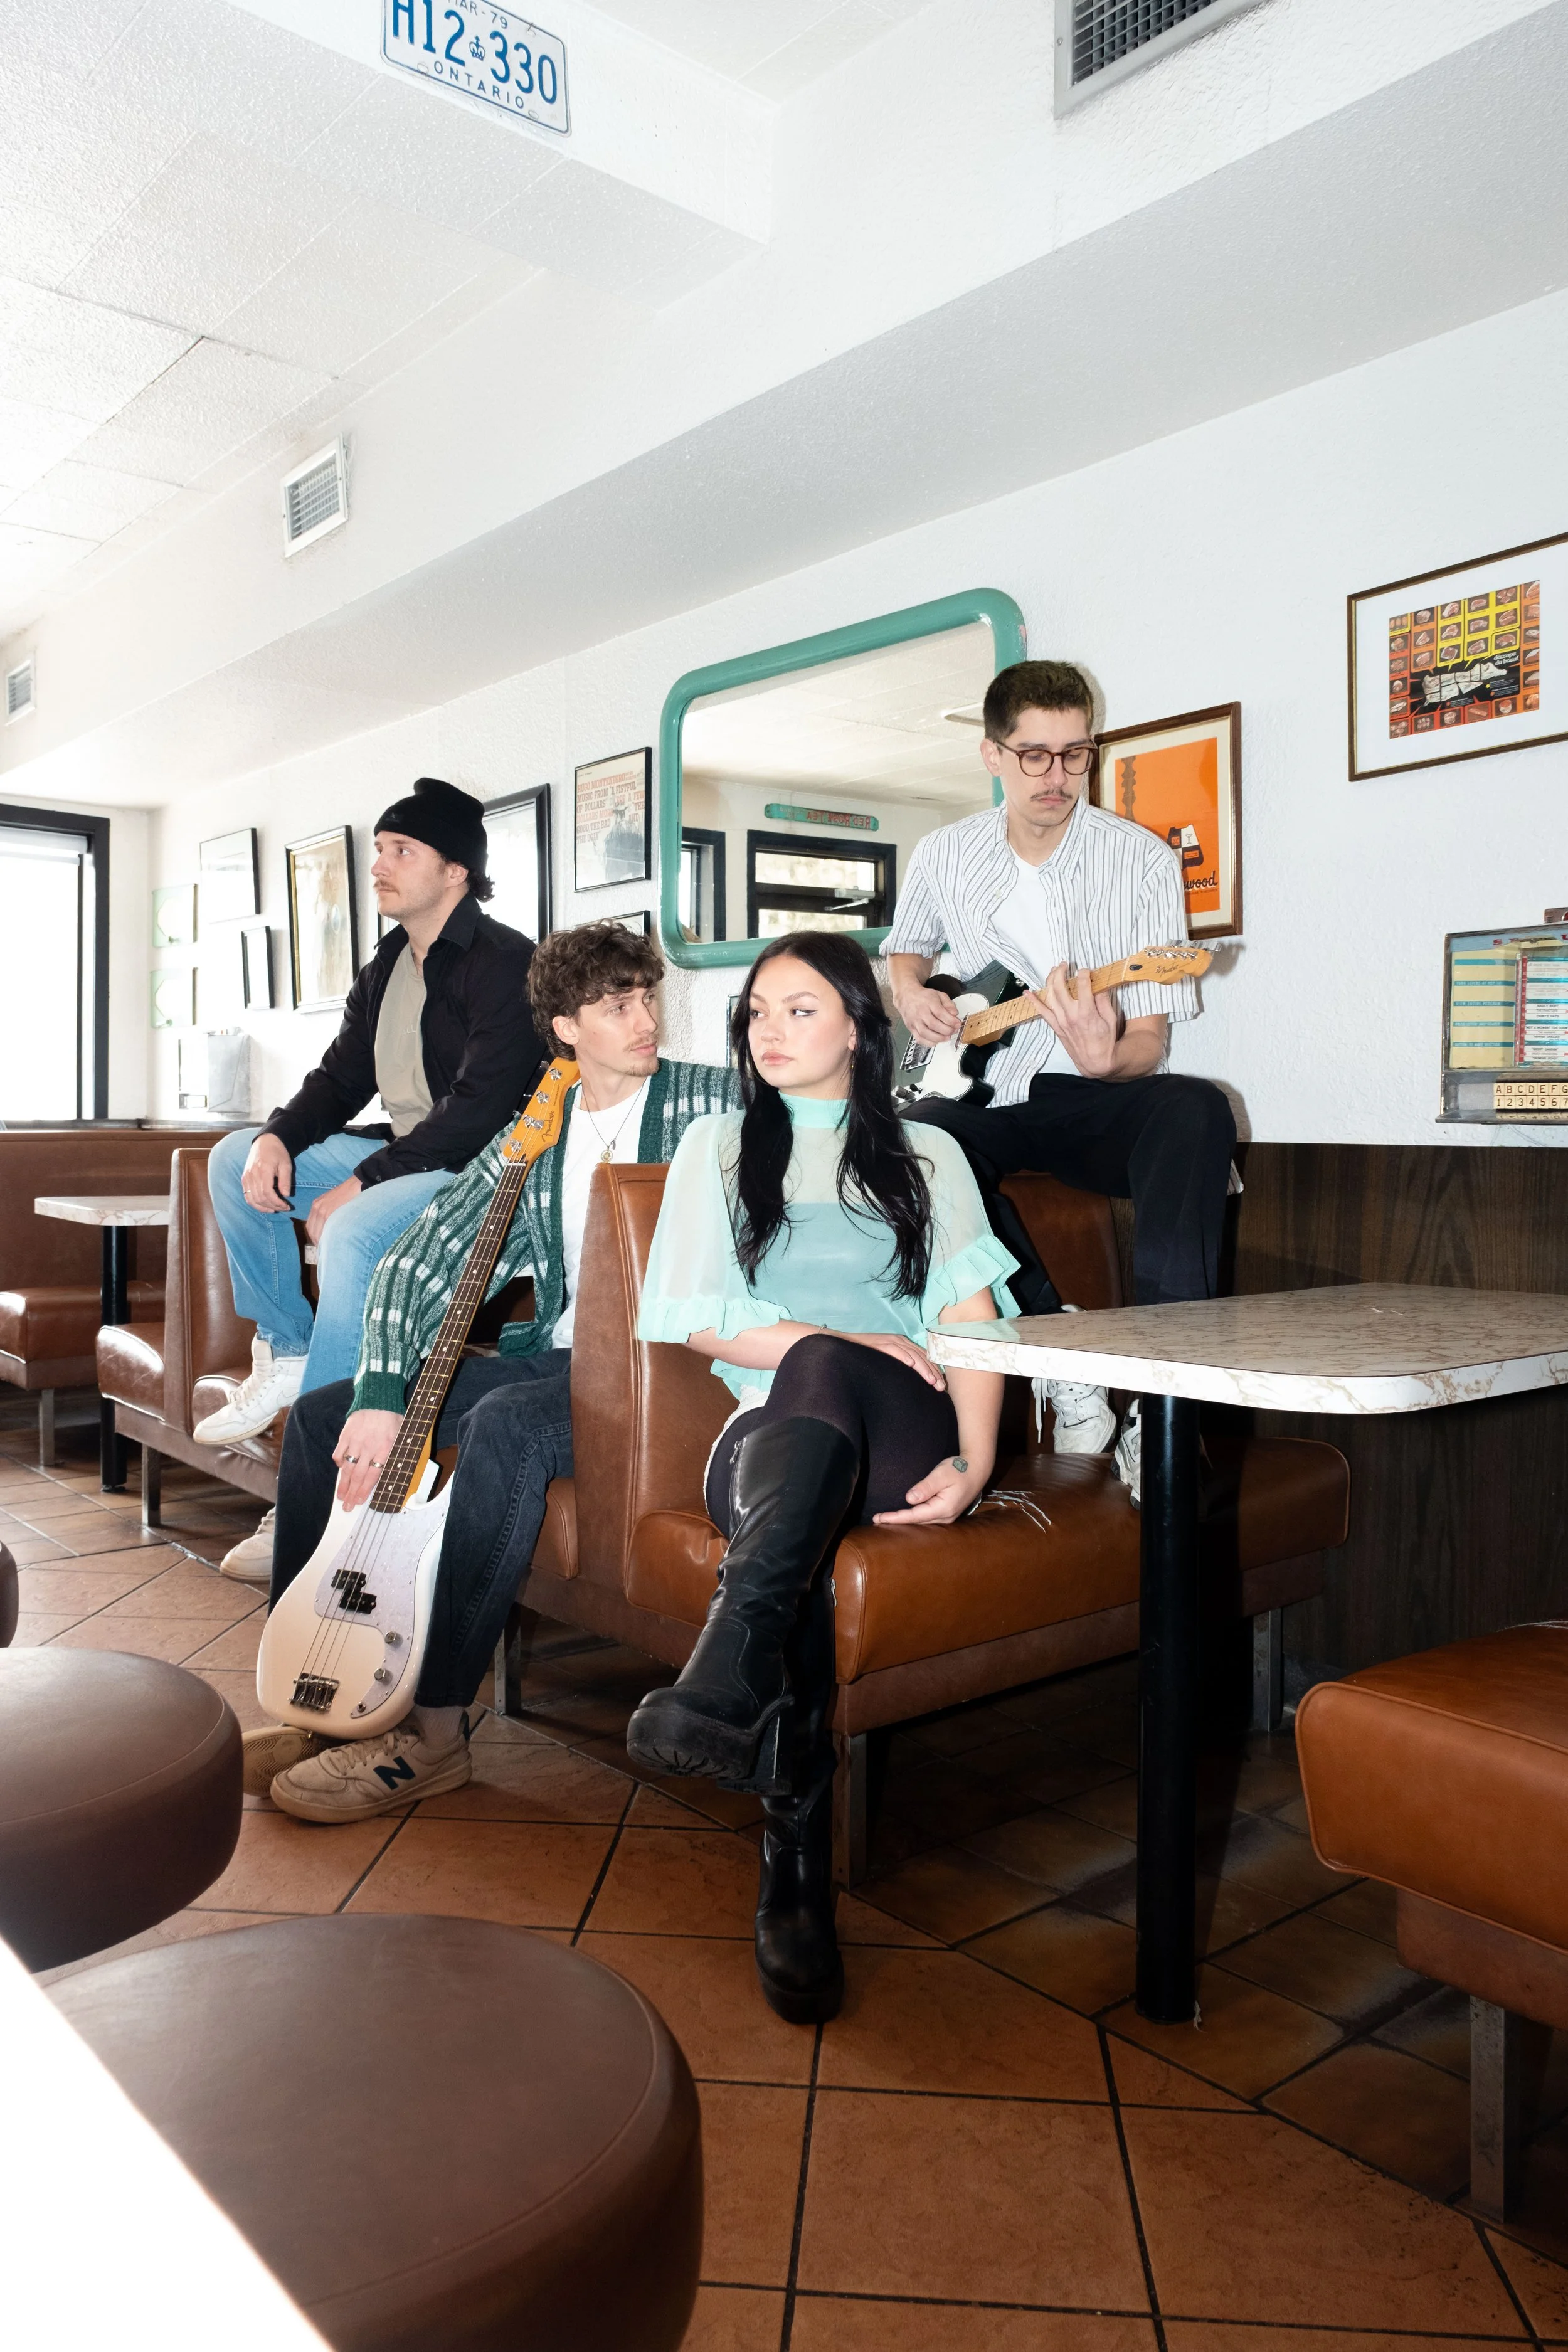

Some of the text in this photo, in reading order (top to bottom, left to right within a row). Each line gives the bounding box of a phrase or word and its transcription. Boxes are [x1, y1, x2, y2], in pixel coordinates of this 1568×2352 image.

[489, 30, 557, 104] 330
[434, 60, 524, 109] ONTARIO
[577, 792, 593, 803] MUSIC
[594, 788, 608, 799] FROM
[616, 781, 637, 794] FISTFUL
[578, 782, 590, 793] HUGO
[577, 804, 583, 813] OF
[634, 790, 644, 801] FEW
[590, 822, 600, 831] THE
[601, 819, 611, 829] BAD
[1540, 1085, 1545, 1093] E
[542, 1110, 555, 1142] Fender
[373, 1755, 416, 1790] N
